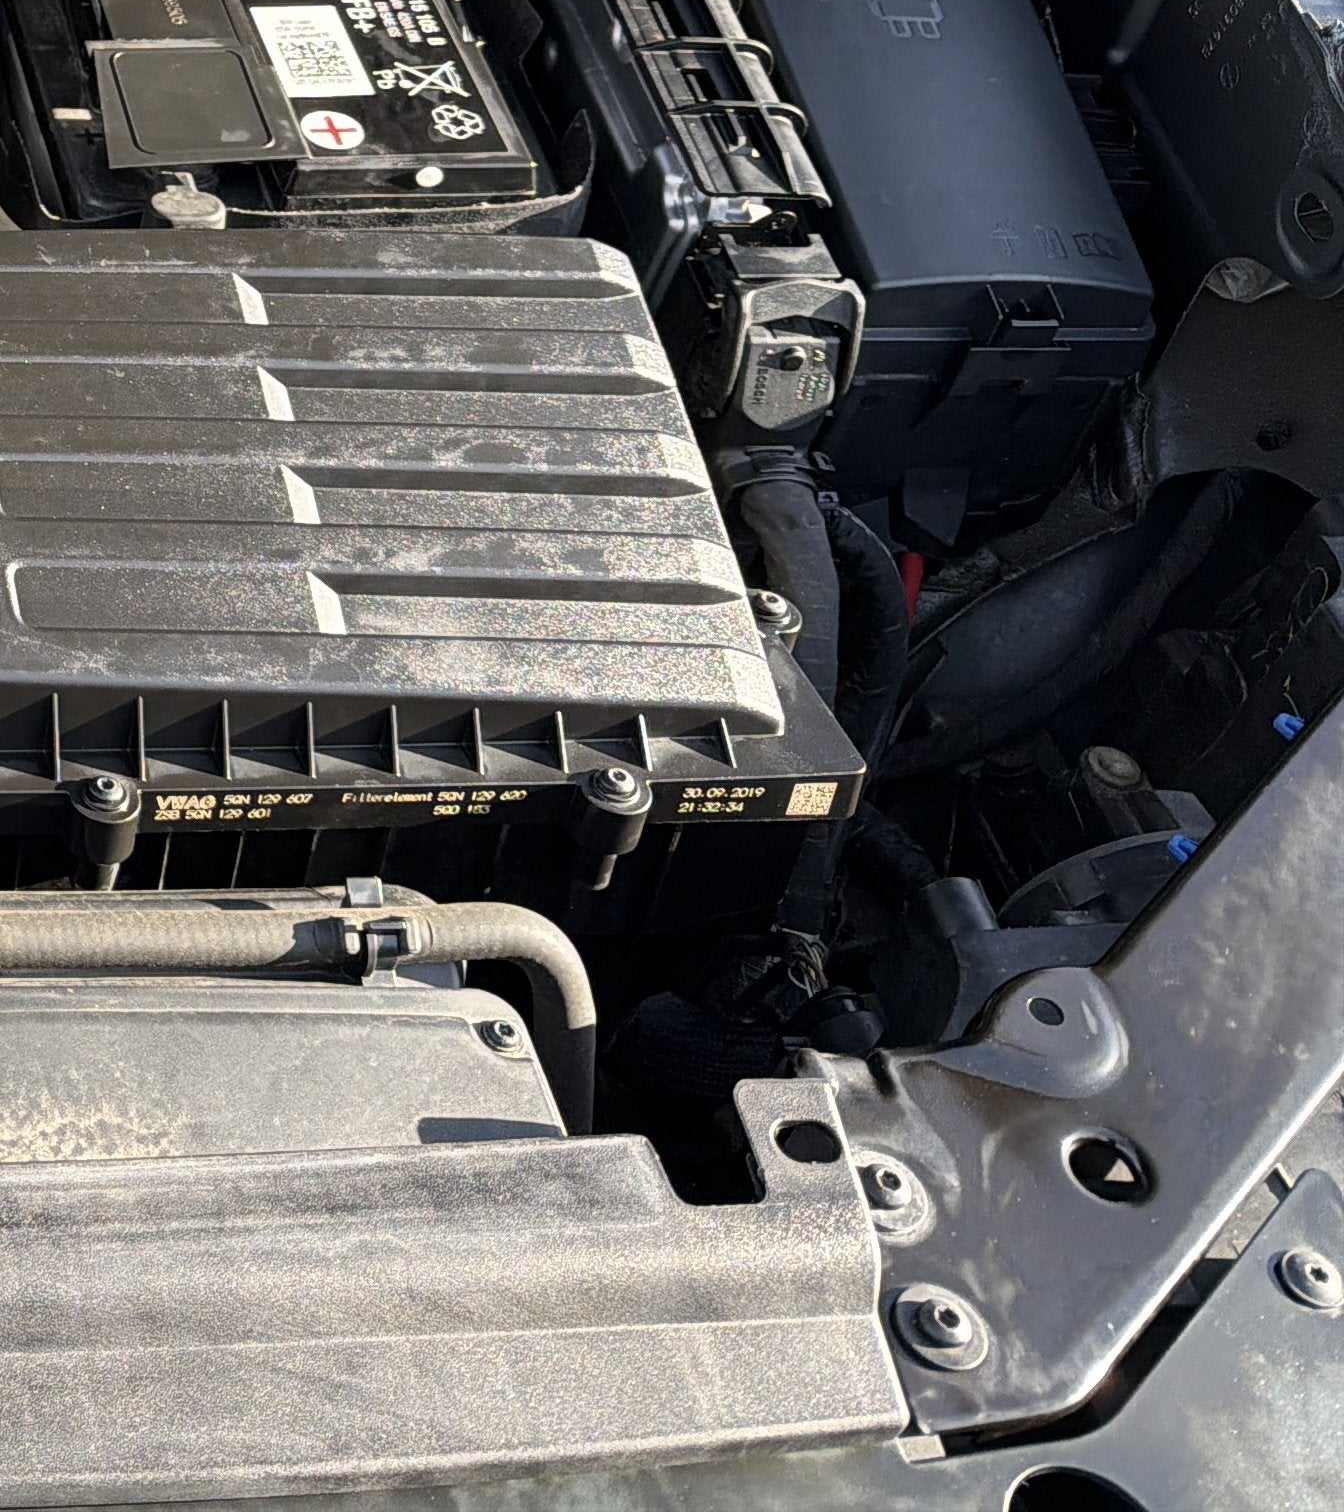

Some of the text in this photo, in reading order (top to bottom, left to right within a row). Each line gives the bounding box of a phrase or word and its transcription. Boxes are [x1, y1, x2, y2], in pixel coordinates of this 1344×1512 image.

[416, 14, 441, 33] 105
[373, 69, 397, 89] Pb
[341, 791, 433, 804] Filterelement
[471, 790, 496, 802] 129
[499, 790, 528, 802] 620
[683, 787, 766, 799] 30.09.2019
[155, 795, 217, 810] VWAG
[258, 793, 282, 805] 129
[285, 793, 314, 804] 607
[678, 801, 745, 813] 21:32:34
[154, 809, 180, 821] ZSB
[219, 808, 244, 820] 129
[247, 808, 272, 819] 601
